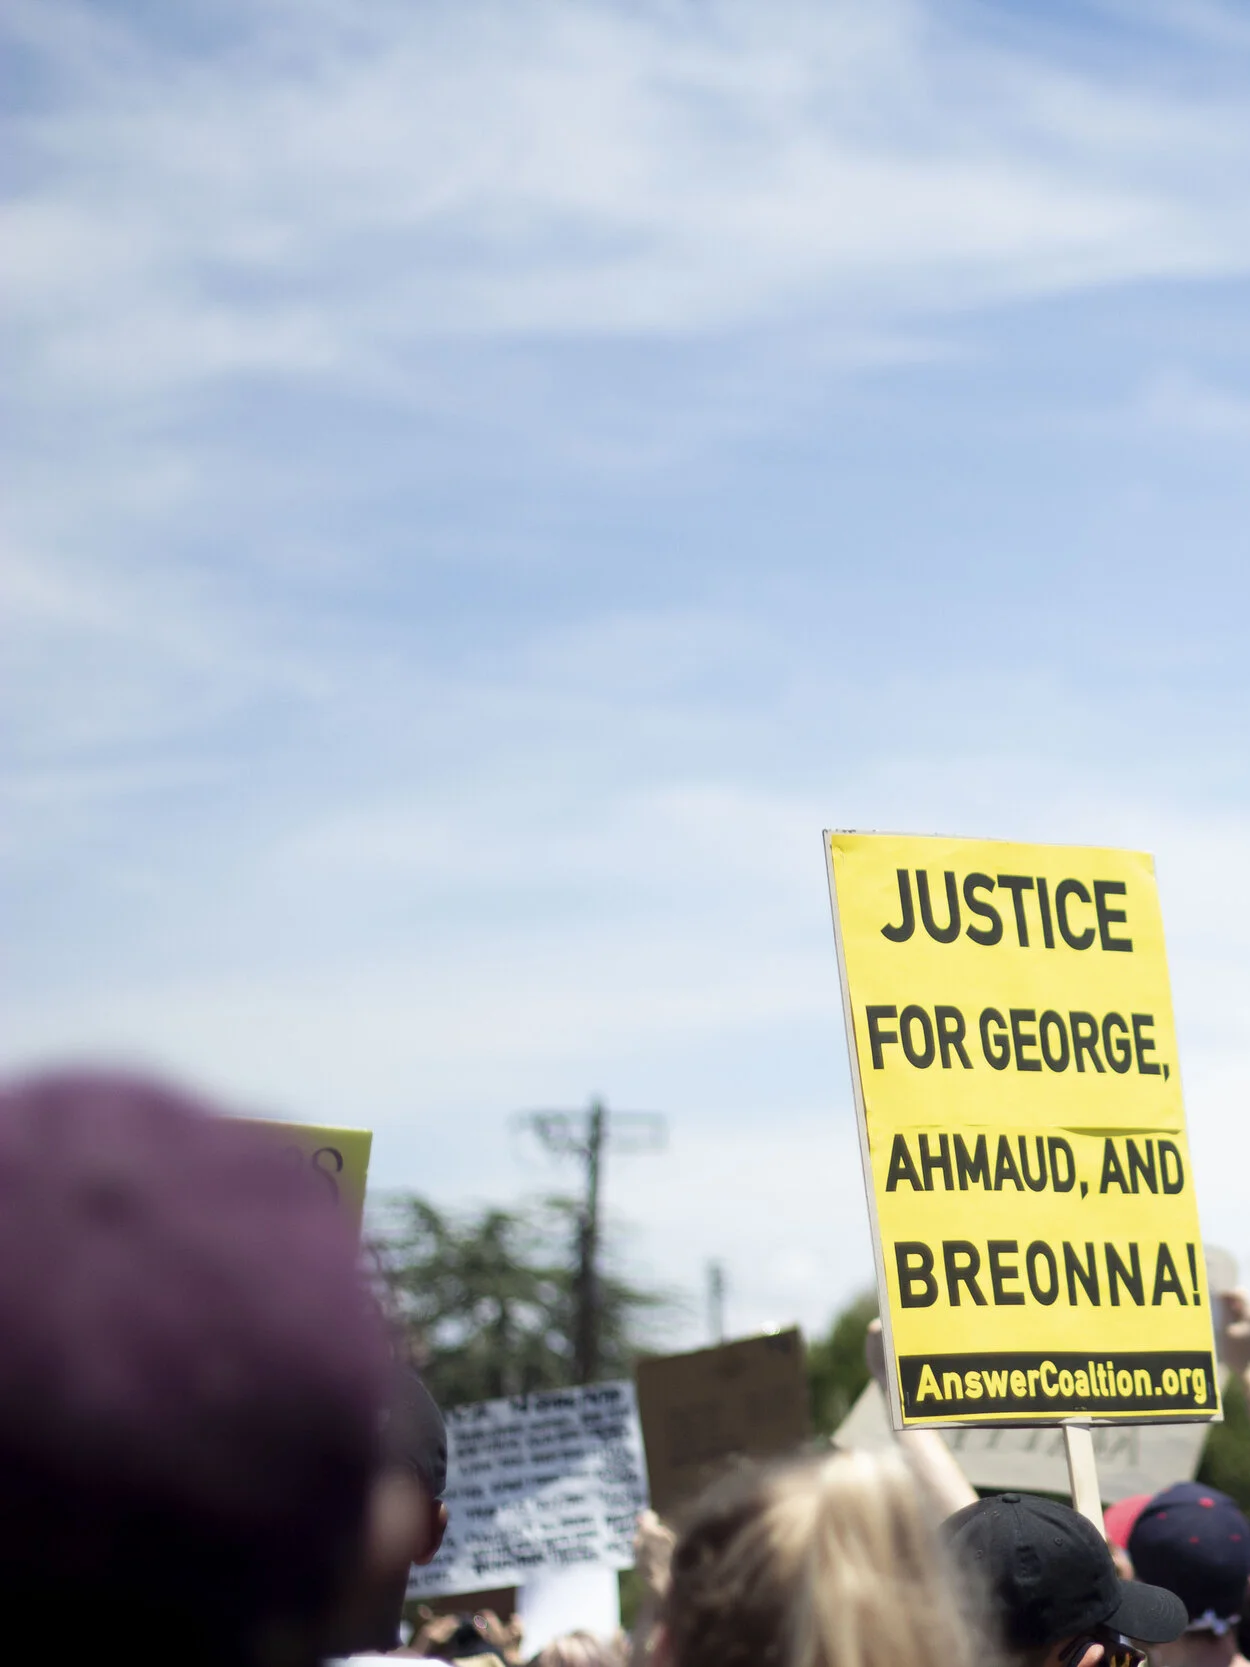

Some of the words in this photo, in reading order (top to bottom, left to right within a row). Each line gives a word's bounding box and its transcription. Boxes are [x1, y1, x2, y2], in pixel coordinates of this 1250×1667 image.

[880, 868, 1133, 953] JUSTICE
[866, 1005, 974, 1070] FOR
[979, 1007, 1171, 1082] GEORGE,
[886, 1133, 1089, 1200] AHMAUD,
[1099, 1138, 1185, 1195] AND
[894, 1240, 1202, 1308] BREONNA!
